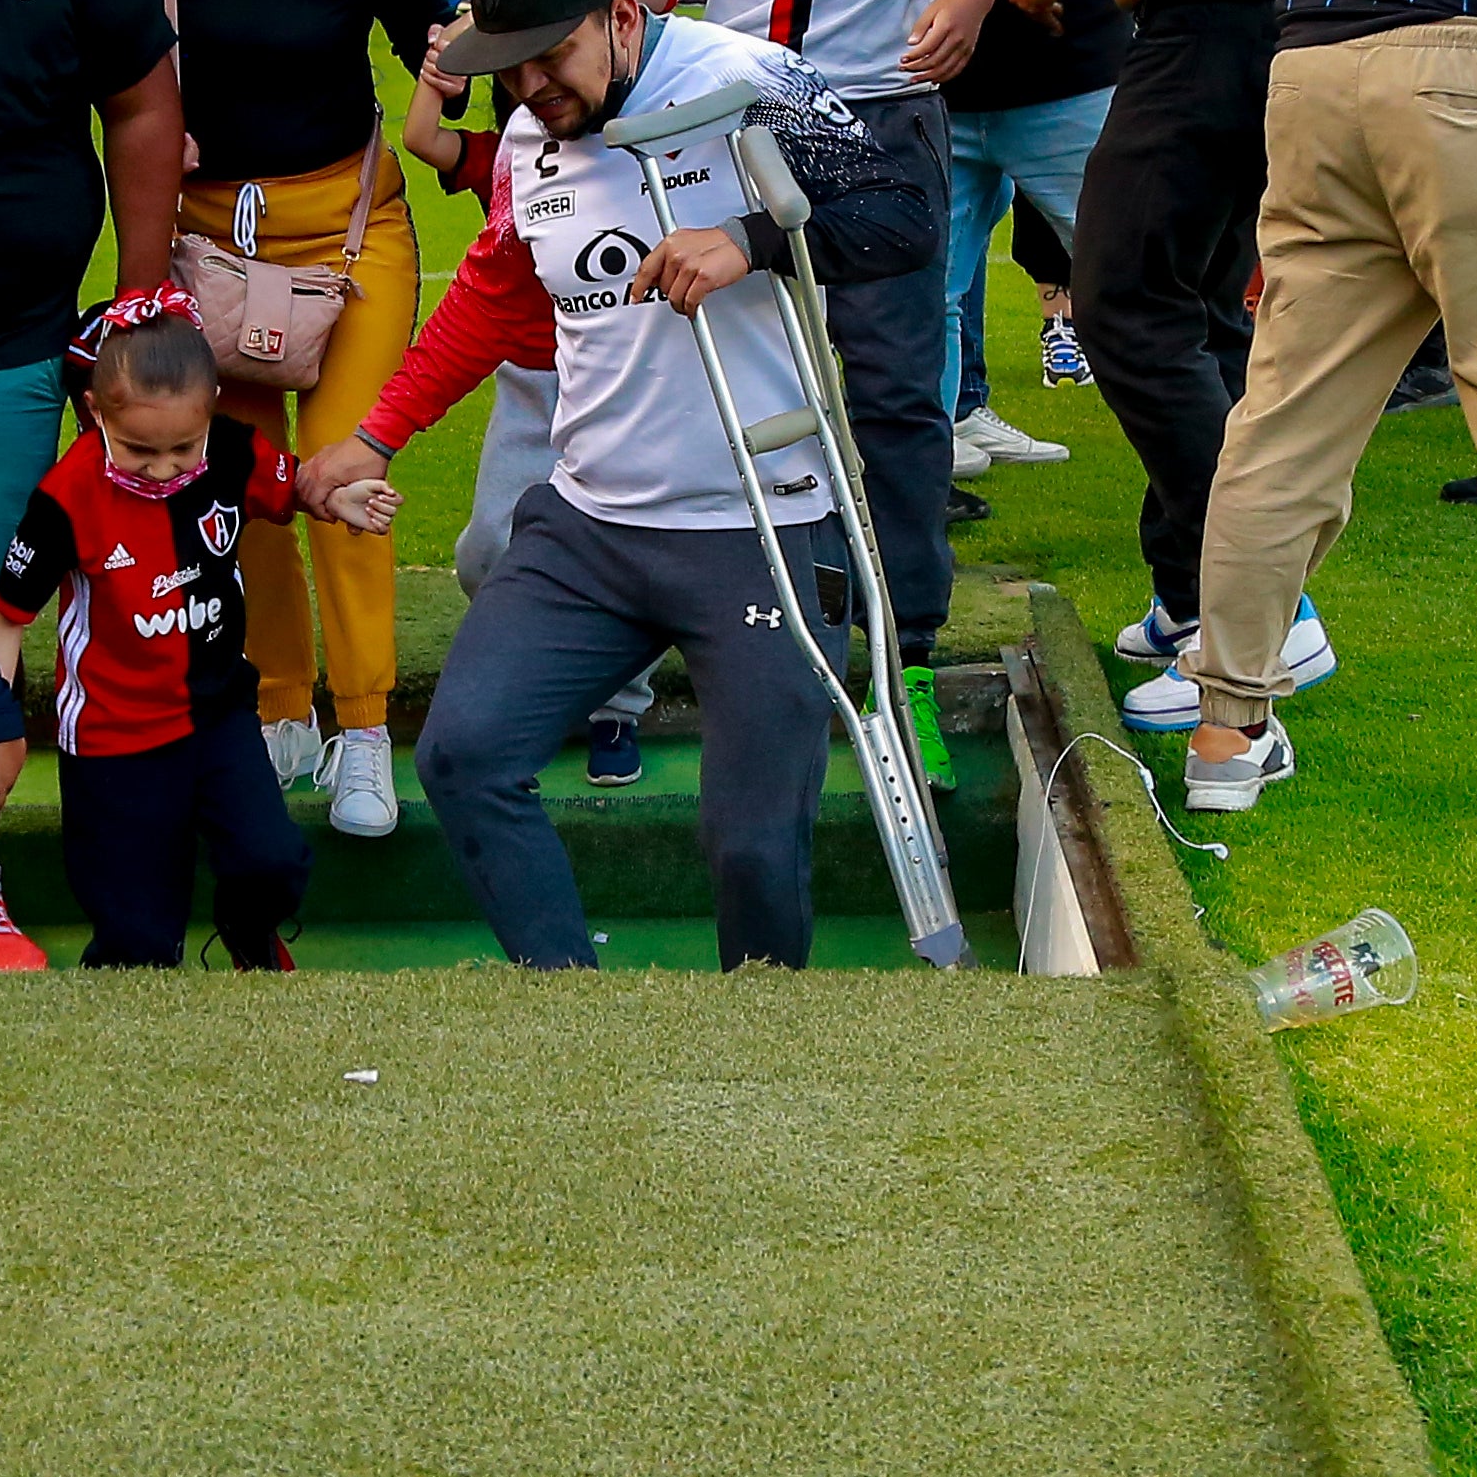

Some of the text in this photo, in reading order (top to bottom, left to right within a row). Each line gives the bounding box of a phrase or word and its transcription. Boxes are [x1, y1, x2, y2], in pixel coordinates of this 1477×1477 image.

[527, 196, 571, 221] URREA
[104, 557, 136, 570] adidas
[134, 595, 222, 639] wibe
